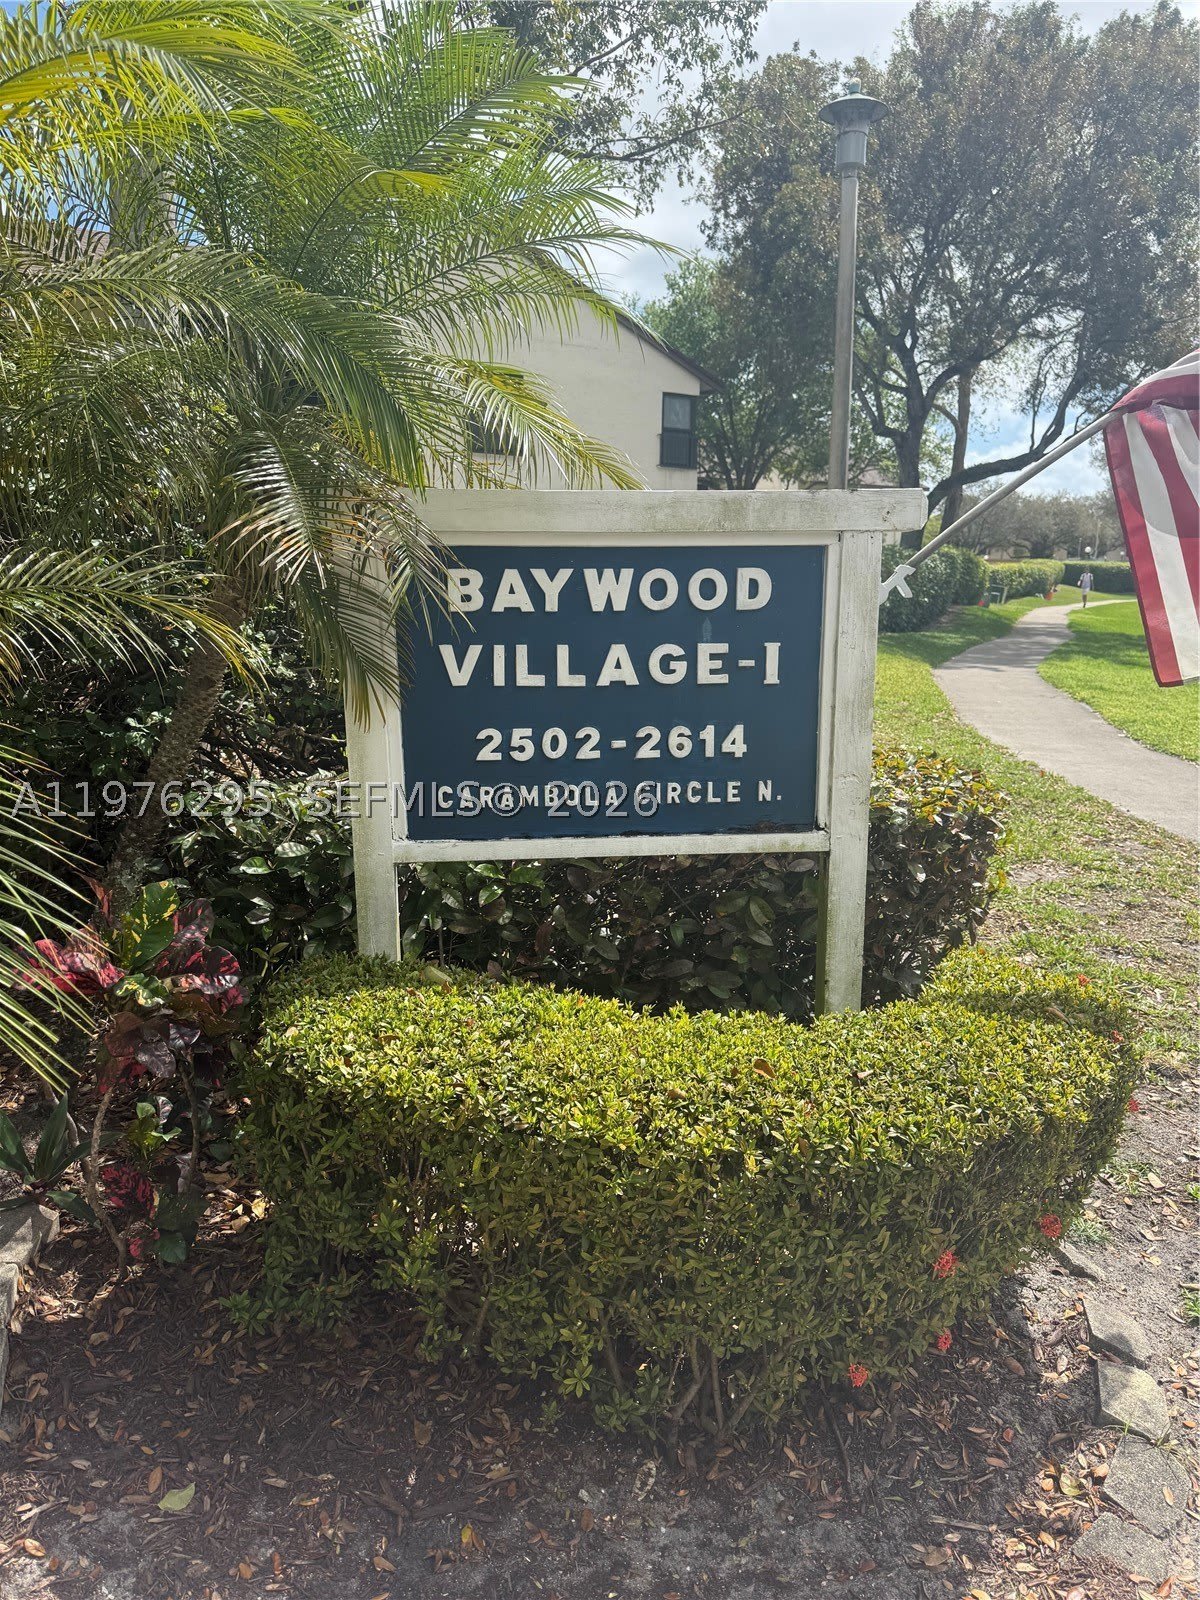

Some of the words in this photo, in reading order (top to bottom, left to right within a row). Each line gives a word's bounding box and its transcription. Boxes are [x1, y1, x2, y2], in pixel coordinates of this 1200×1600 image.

[446, 567, 773, 614] BAYWOOD
[438, 642, 782, 688] VILLAGE-I
[475, 724, 748, 762] 2502-2614
[437, 783, 619, 810] CARAMBOLA
[636, 780, 742, 805] CIRCLE
[757, 779, 783, 802] N.
